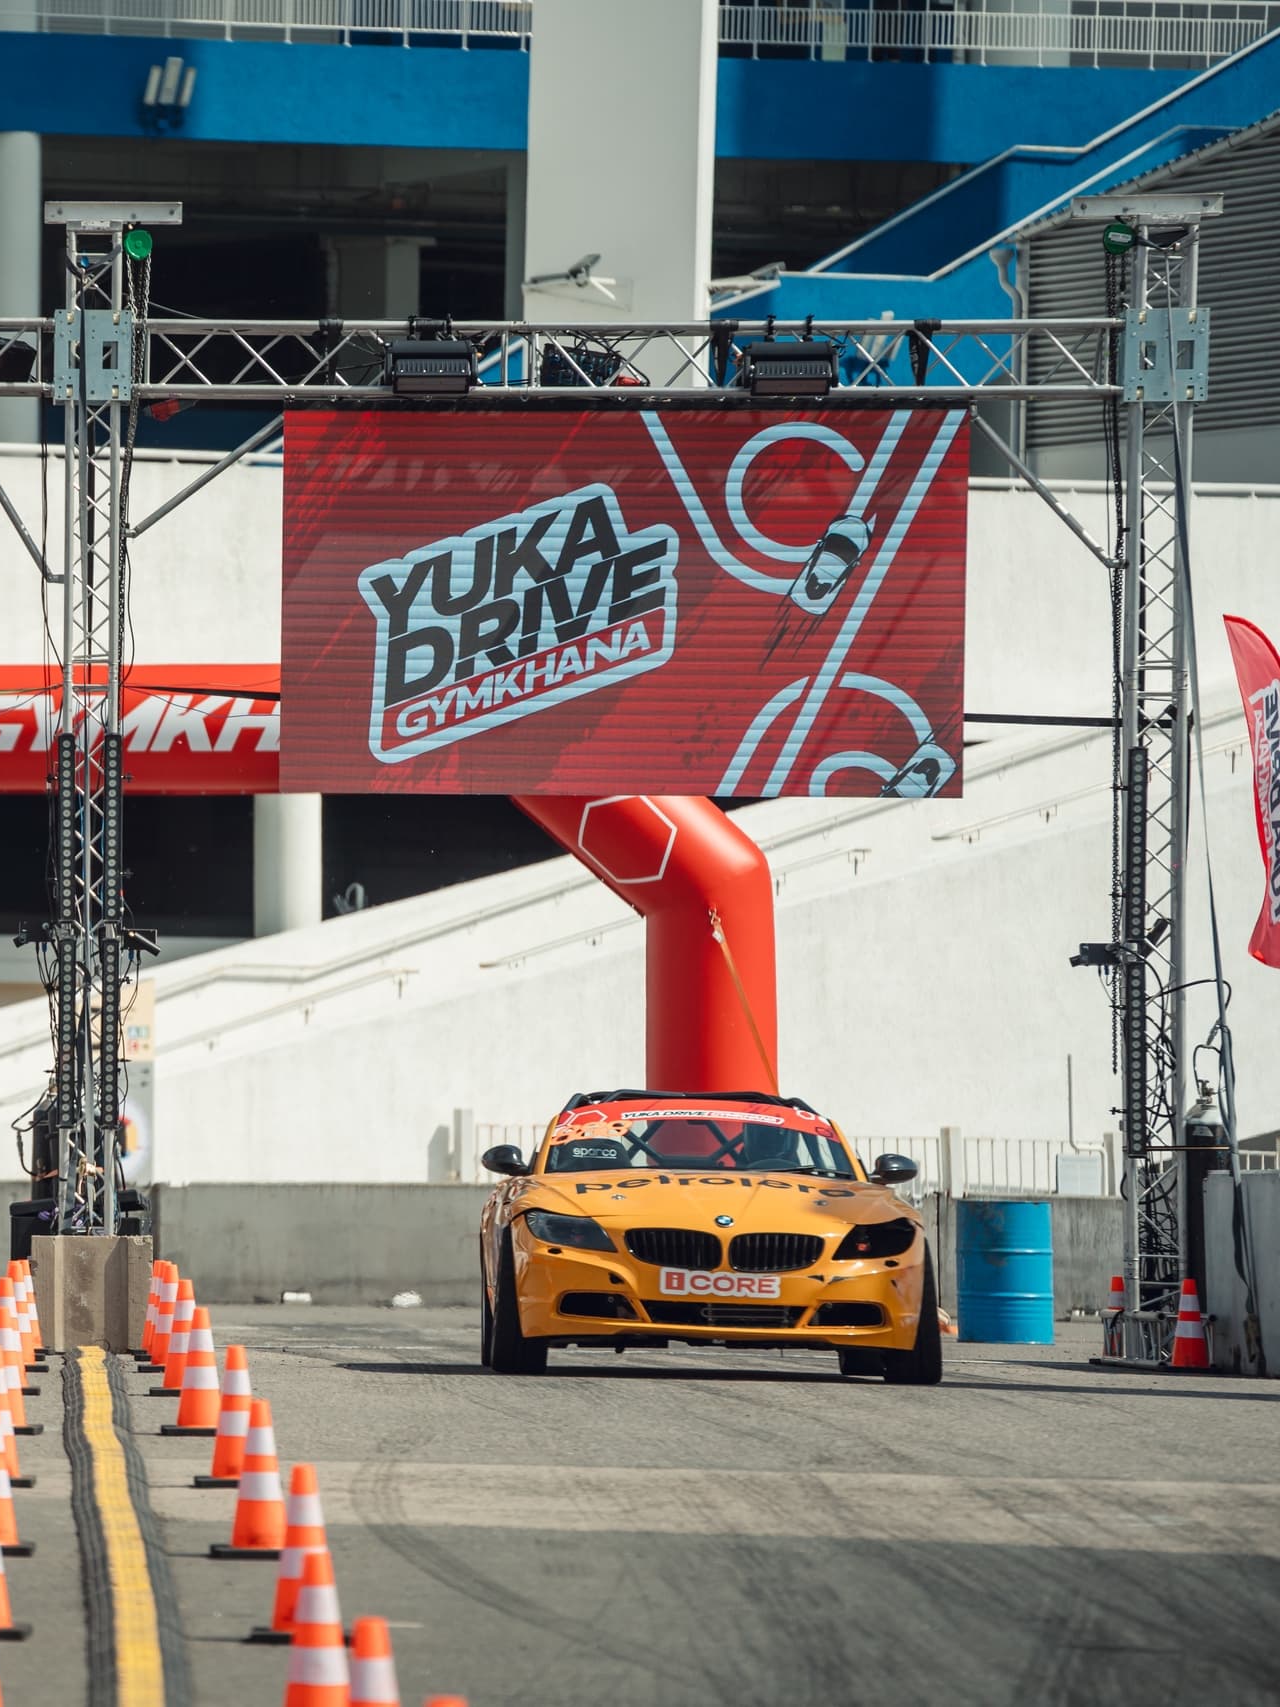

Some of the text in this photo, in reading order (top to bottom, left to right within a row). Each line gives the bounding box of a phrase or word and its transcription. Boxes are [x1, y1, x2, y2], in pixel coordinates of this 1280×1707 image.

[369, 494, 619, 640] YUKA
[384, 537, 668, 708] DRIVE
[395, 621, 651, 738] GYMKHANA
[623, 1111, 660, 1119] YUKA
[575, 1174, 855, 1198] petrolero
